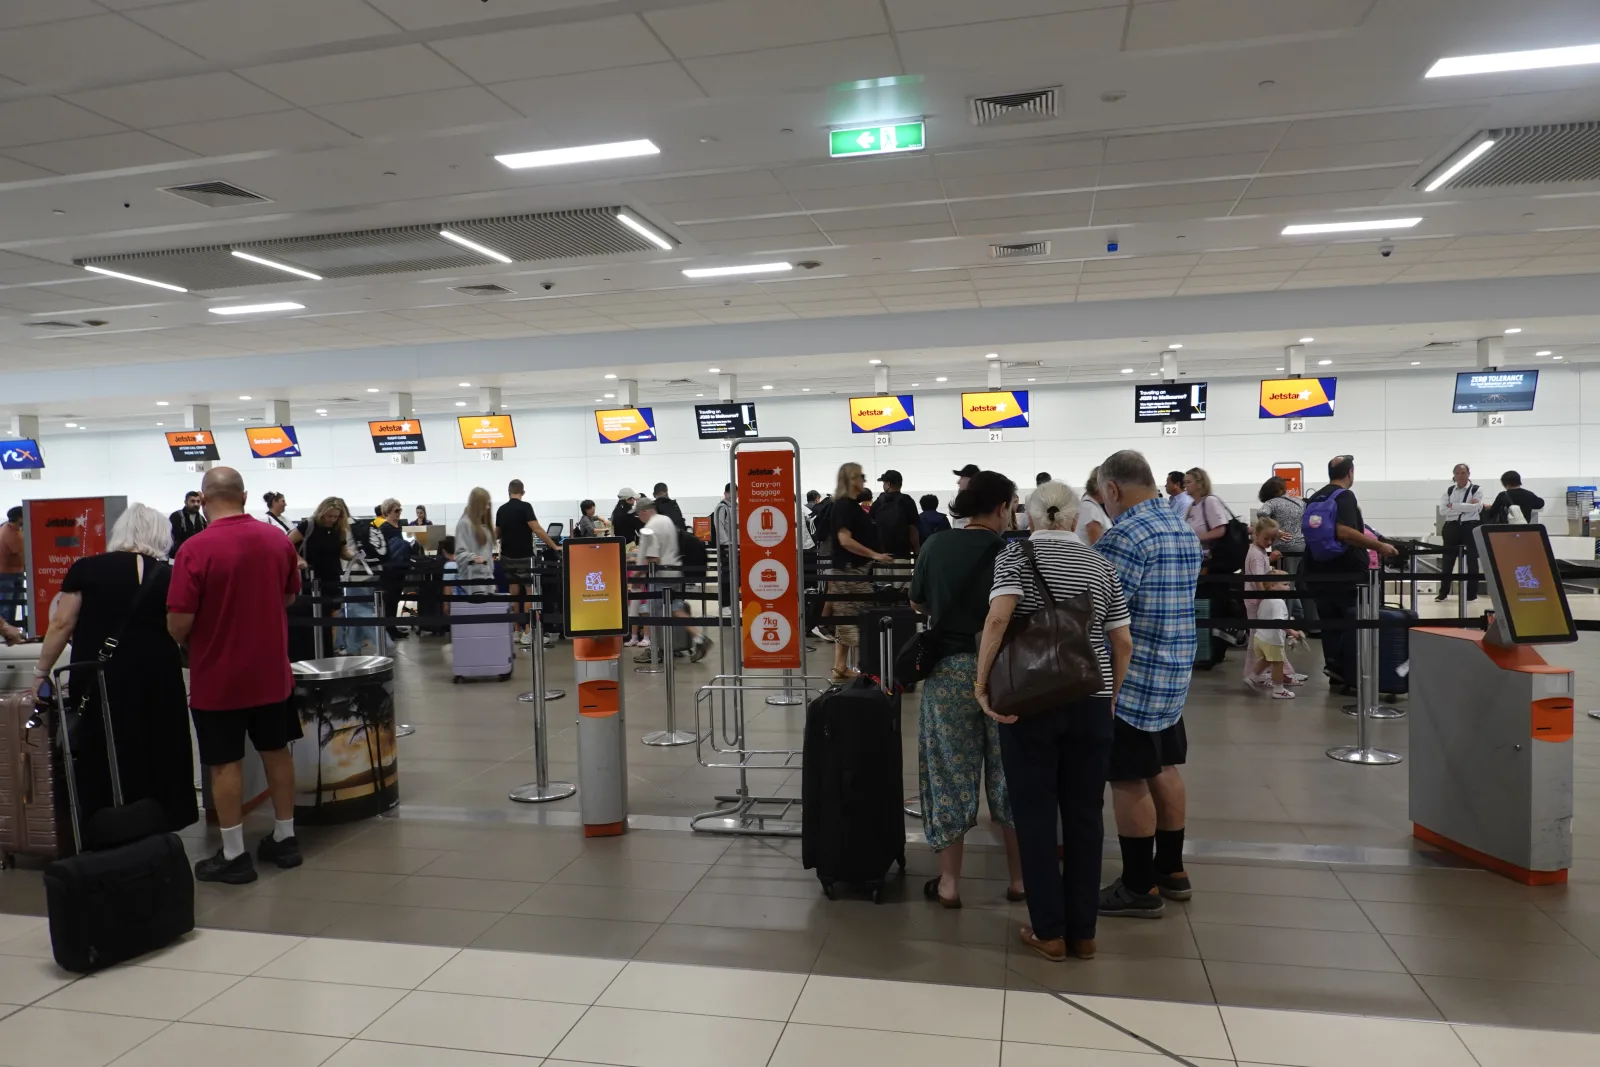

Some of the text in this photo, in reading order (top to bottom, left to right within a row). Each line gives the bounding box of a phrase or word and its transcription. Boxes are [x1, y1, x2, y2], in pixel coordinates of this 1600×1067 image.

[1488, 374, 1524, 382] TOLERANCE
[1491, 417, 1502, 425] 24
[751, 481, 780, 489] Carry-on
[751, 489, 780, 497] baggage
[49, 555, 70, 565] Weigh
[38, 567, 68, 576] carry-on
[763, 617, 778, 626] 7kg
